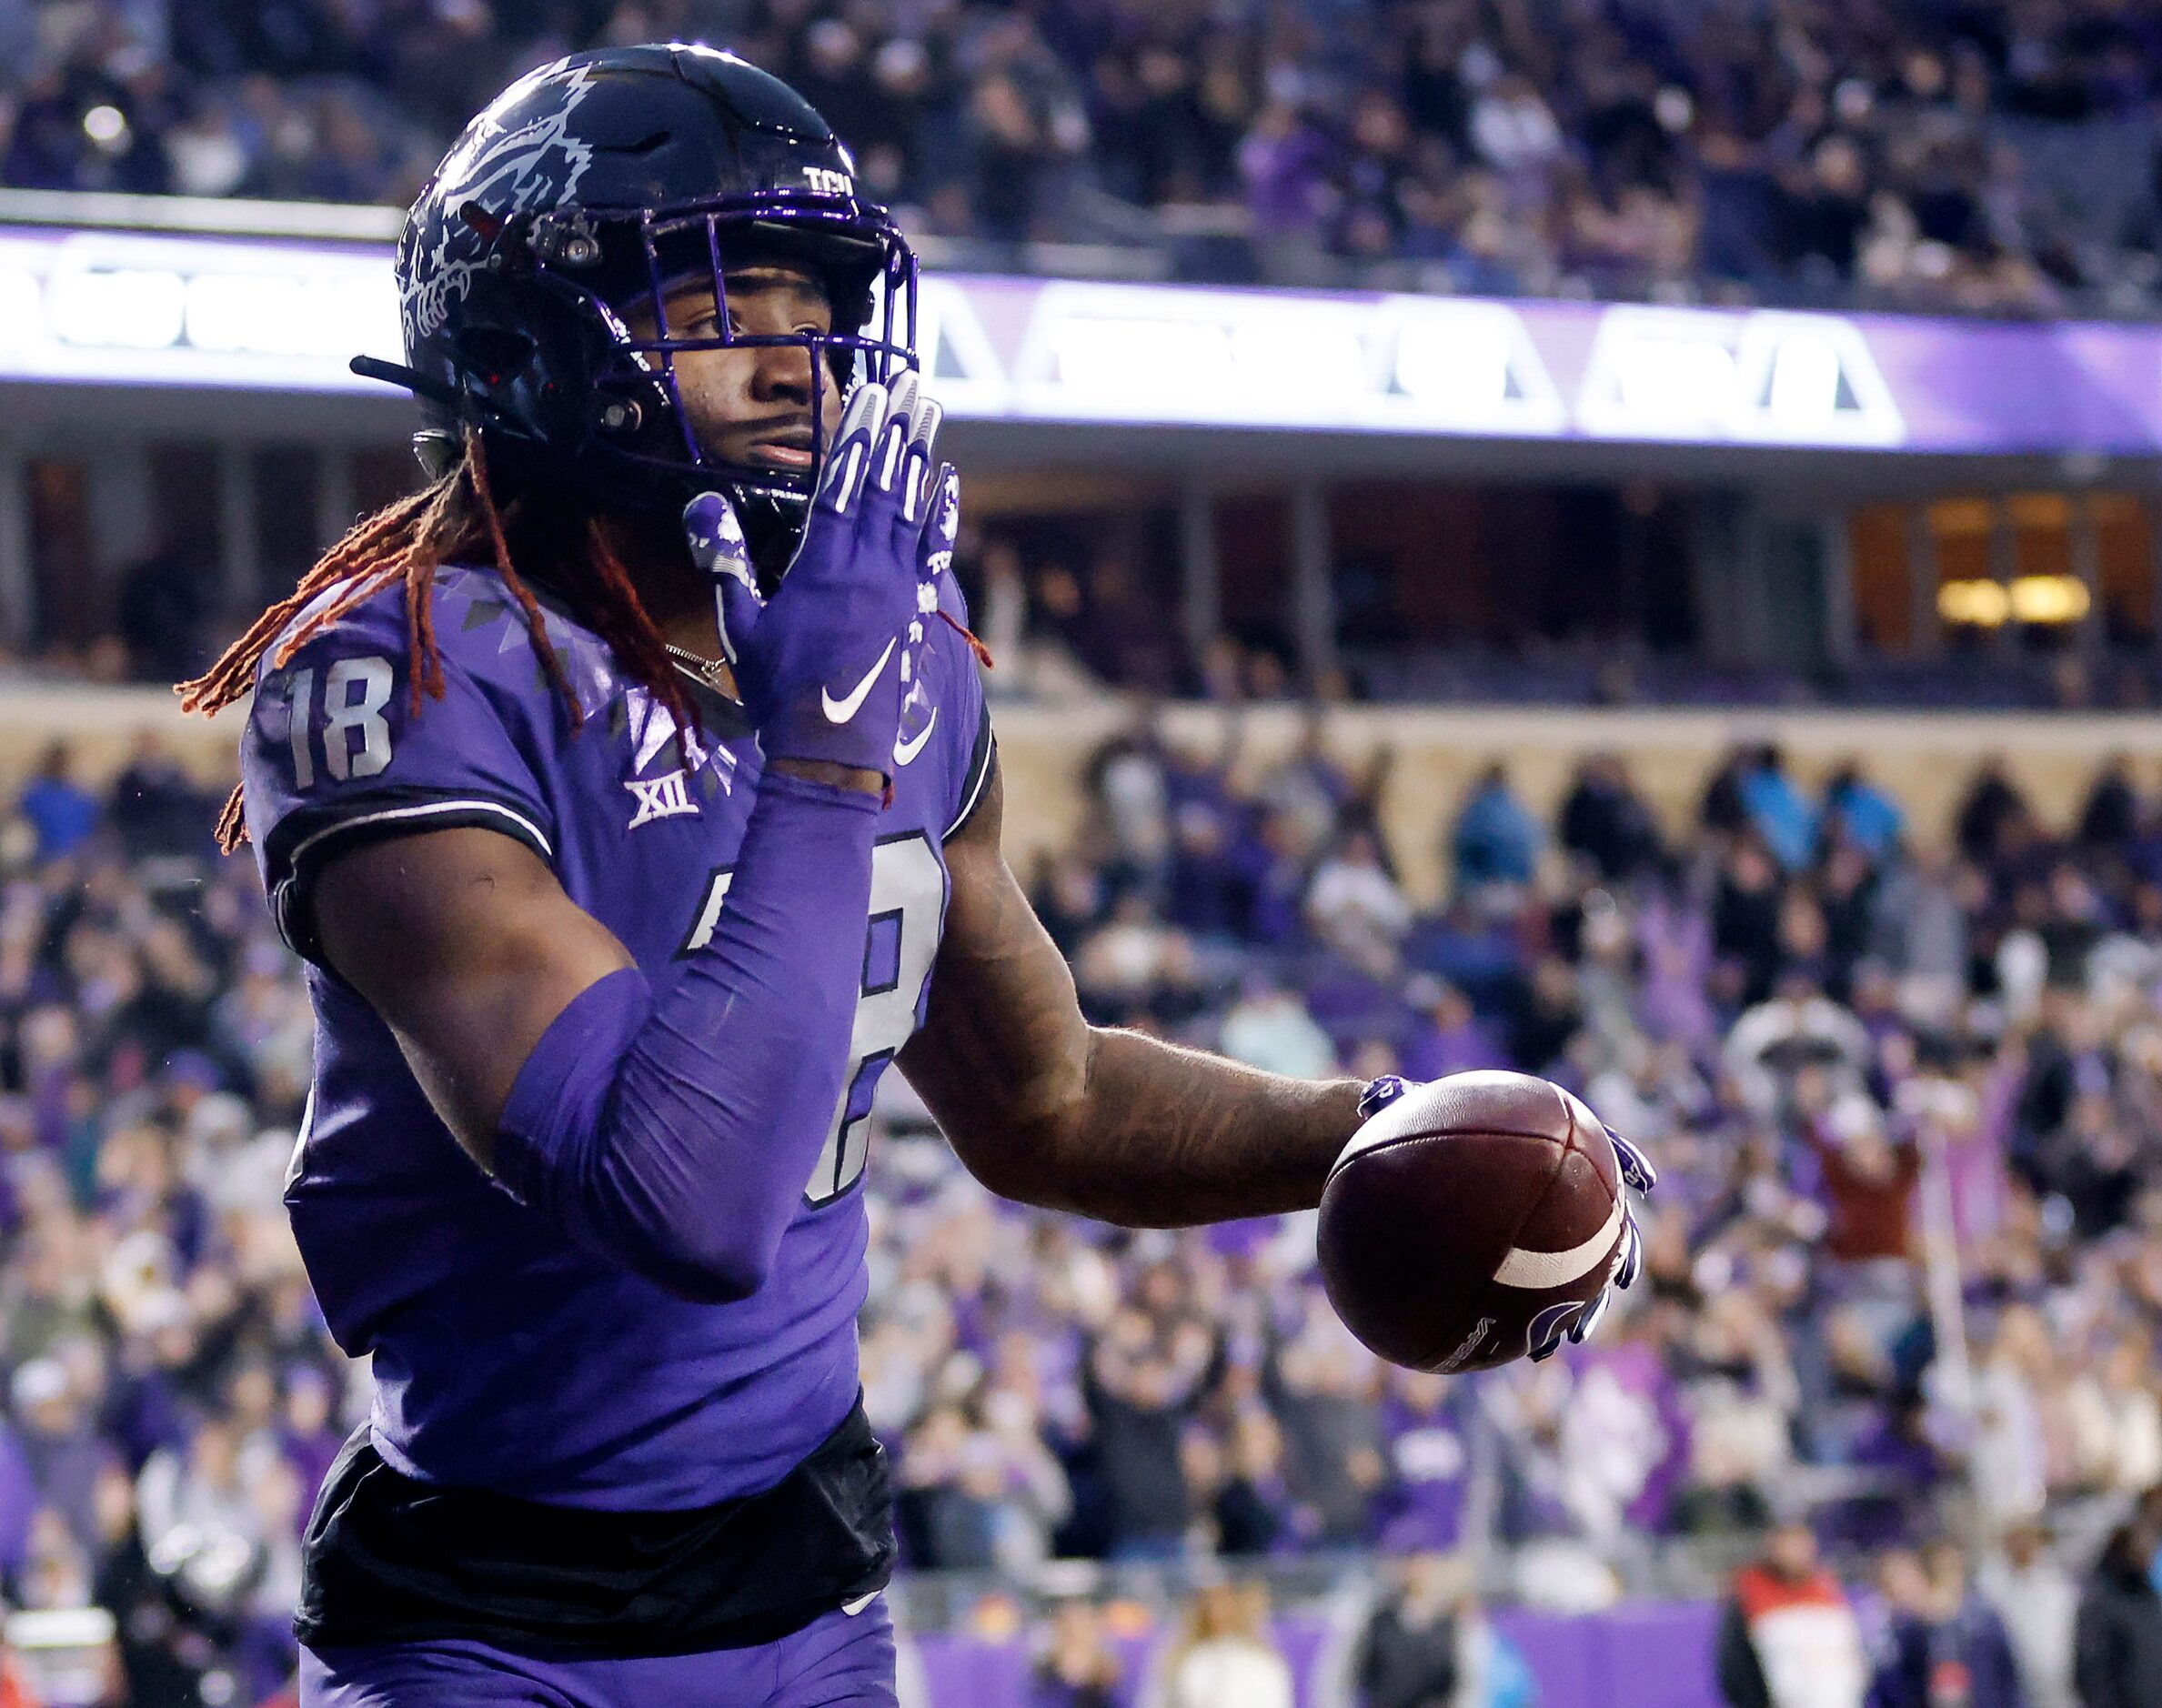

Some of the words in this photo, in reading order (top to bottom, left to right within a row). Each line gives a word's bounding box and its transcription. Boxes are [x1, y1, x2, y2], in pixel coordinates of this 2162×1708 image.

[802, 166, 854, 196] TCU
[287, 656, 394, 790] 18
[623, 769, 699, 829] XII
[679, 831, 946, 1206] 8
